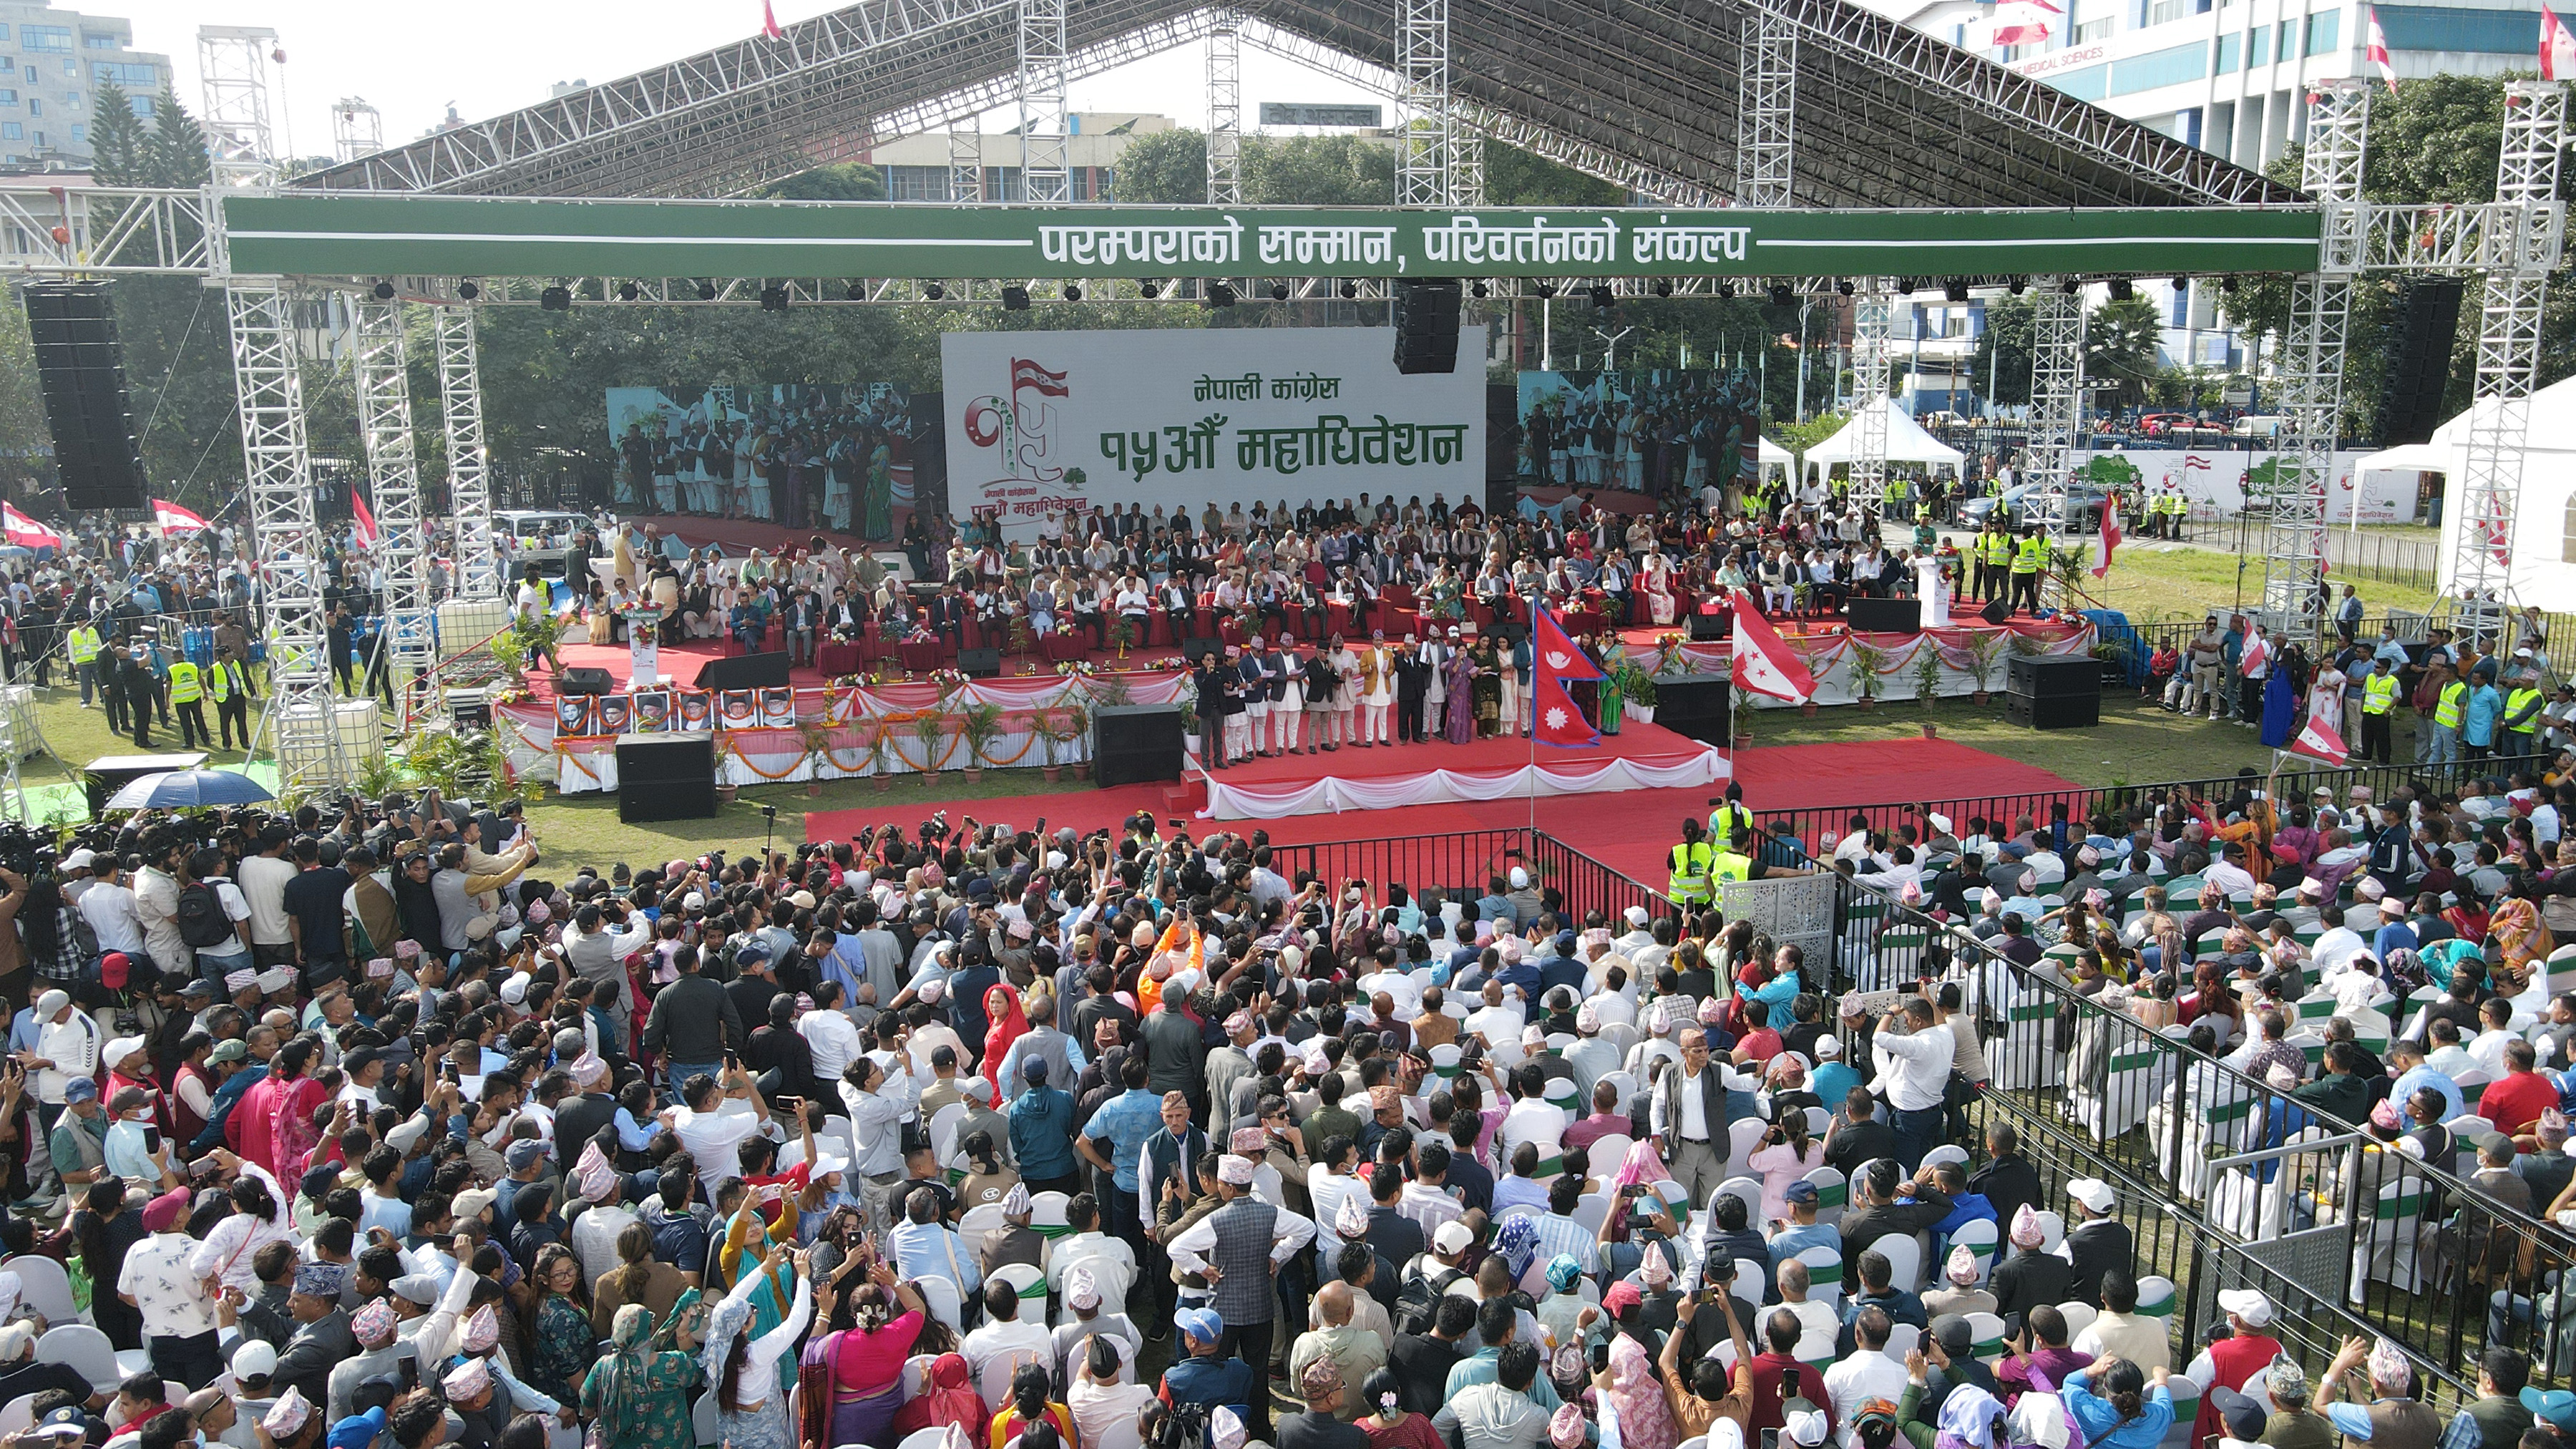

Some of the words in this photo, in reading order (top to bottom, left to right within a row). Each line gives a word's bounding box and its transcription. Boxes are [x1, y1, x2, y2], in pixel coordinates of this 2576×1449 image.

[2023, 57, 2059, 75] MEDICAL
[2061, 47, 2104, 67] SCIENCES
[1303, 108, 1373, 125] अस्पताल
[1038, 215, 1245, 265] परम्पराको
[1258, 225, 1406, 273] सम्मान,
[1422, 216, 1621, 265] परिवर्तनको
[1632, 215, 1752, 263] संकल्प
[1194, 371, 1264, 403] नेपाली
[1271, 371, 1342, 404] कांग्रेस
[1100, 412, 1229, 484] १५औँ
[1236, 414, 1469, 475] महाधिवेशन
[985, 489, 1005, 499] नेपाली
